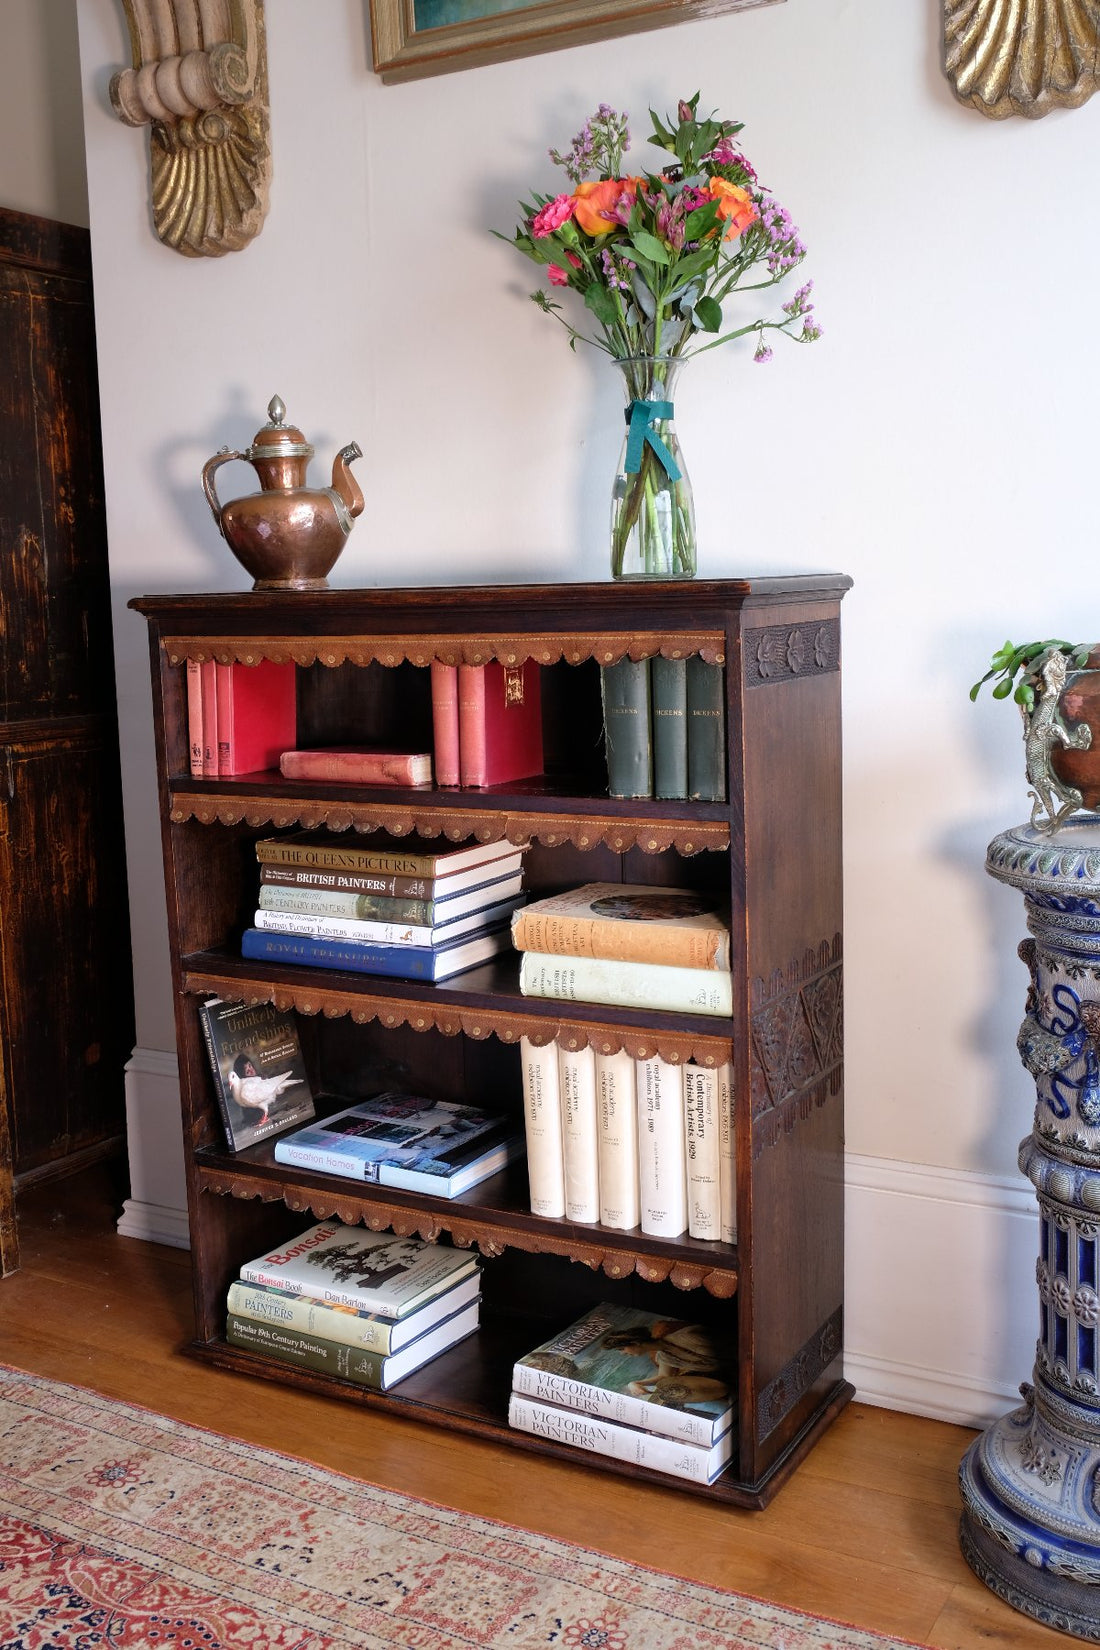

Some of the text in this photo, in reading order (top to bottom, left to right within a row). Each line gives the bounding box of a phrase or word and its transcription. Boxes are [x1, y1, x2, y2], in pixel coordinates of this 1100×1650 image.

[281, 850, 302, 863] THE
[358, 857, 417, 873] PICTURES
[296, 873, 336, 886] BRITISH
[337, 876, 386, 891] PAINTERS
[311, 902, 346, 914] PAINTERS
[317, 925, 348, 937] PAINTERS
[266, 942, 304, 955] ROYAL
[226, 1008, 276, 1033] Unlikely
[220, 1022, 291, 1056] Friendships
[646, 1063, 655, 1096] exhibitors
[654, 1064, 662, 1110] royal academy
[686, 1073, 696, 1105] British
[696, 1073, 707, 1139] Contemporary
[705, 1082, 713, 1116] Dictionary
[705, 1117, 713, 1126] of
[288, 1148, 324, 1165] Vacation
[688, 1140, 697, 1160] 1929
[264, 1227, 336, 1266] Bonsai
[245, 1271, 367, 1310] The Bonsai Book Dan Barton
[265, 1295, 287, 1307] Century
[244, 1298, 293, 1321] PAINTERS
[232, 1321, 328, 1359] Popular 19th Century Painting
[548, 1315, 605, 1353] VICTORIAN
[562, 1322, 612, 1355] PAINTERS
[536, 1385, 600, 1413] PAINTERS
[537, 1372, 612, 1405] VICTORIAN
[532, 1409, 609, 1441] VICTORIAN
[532, 1422, 596, 1449] PAINTERS
